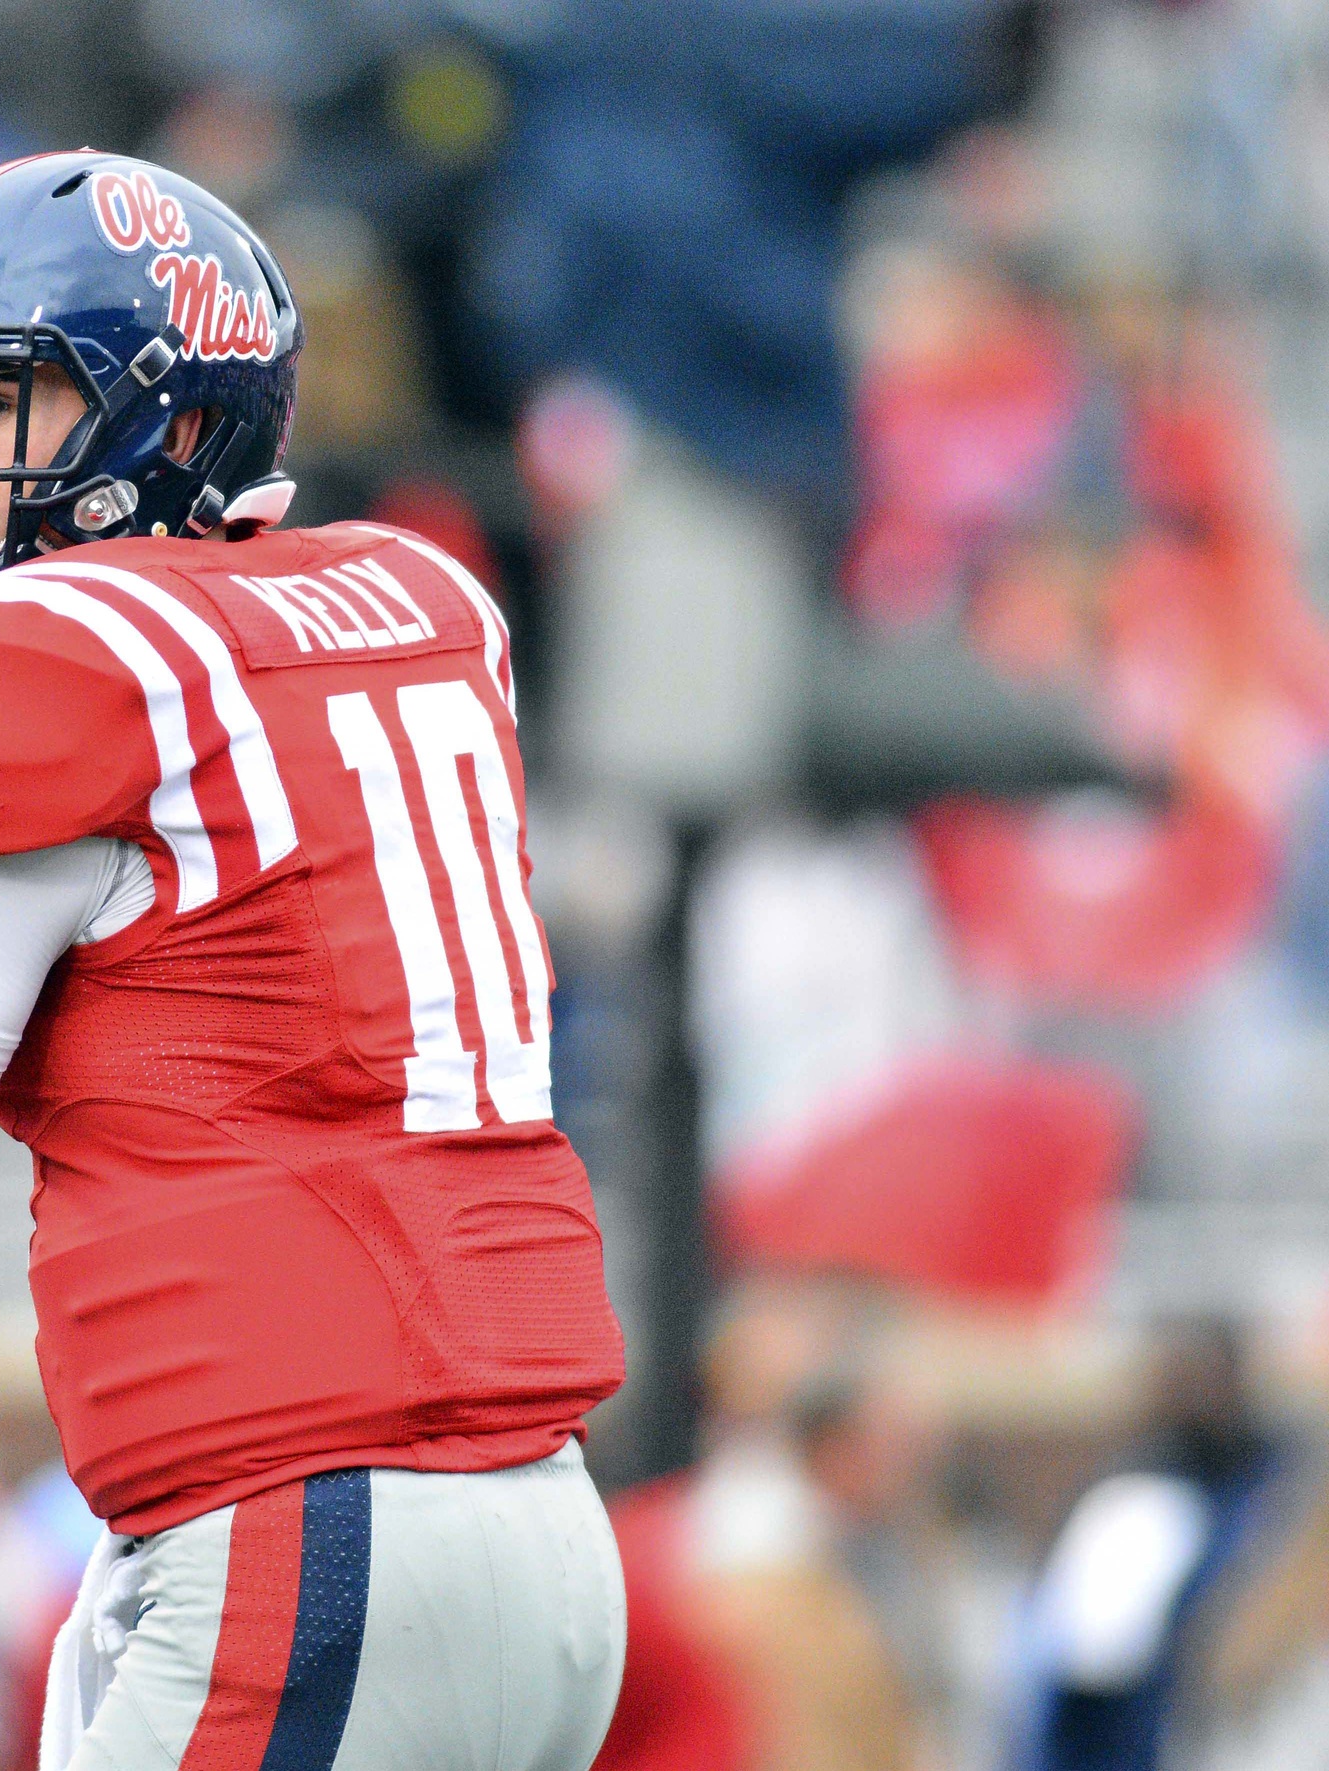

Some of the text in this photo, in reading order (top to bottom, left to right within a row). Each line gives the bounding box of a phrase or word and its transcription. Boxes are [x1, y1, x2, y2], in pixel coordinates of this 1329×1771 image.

[93, 171, 191, 252] Ole
[151, 254, 277, 361] Miss
[229, 557, 437, 653] KELLY
[326, 680, 553, 1133] 10
